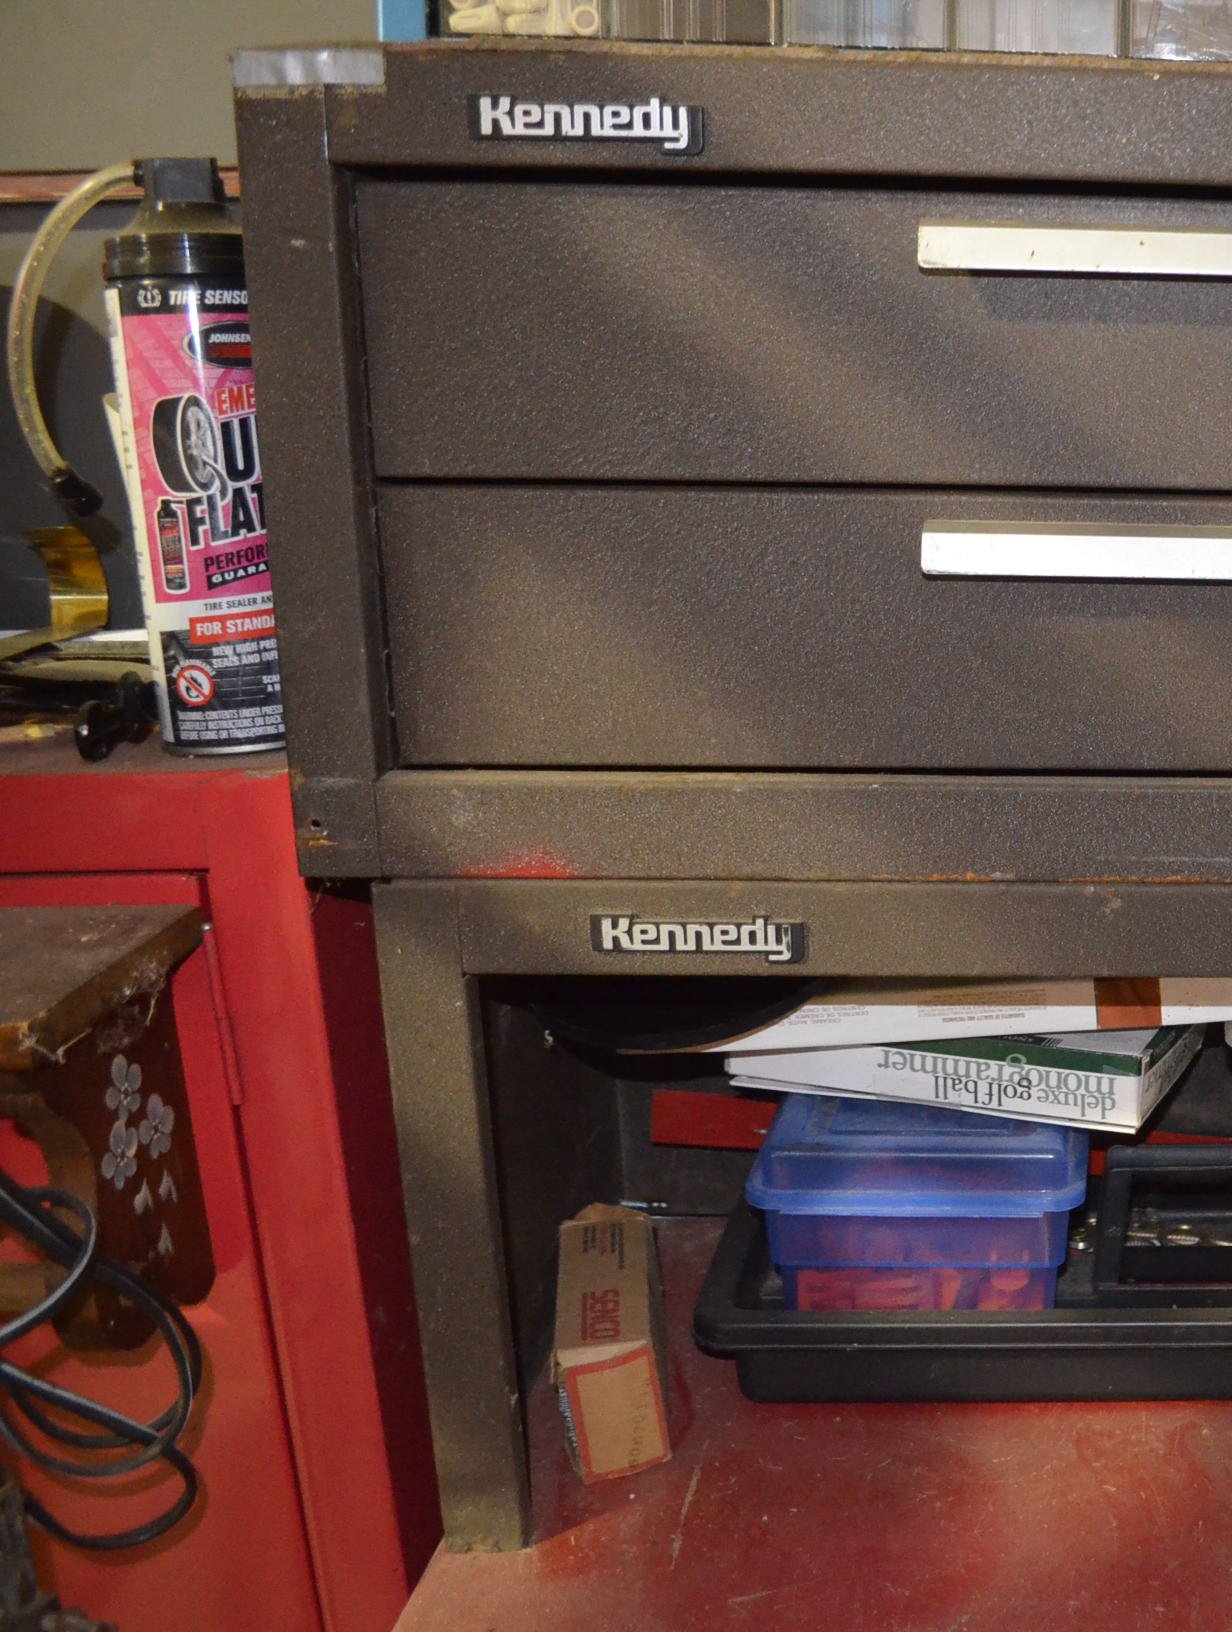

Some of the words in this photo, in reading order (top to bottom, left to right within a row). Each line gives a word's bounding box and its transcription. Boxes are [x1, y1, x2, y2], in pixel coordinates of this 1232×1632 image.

[480, 96, 688, 150] Kennedy
[215, 384, 256, 416] EME
[204, 543, 269, 573] PERFOR
[212, 563, 268, 582] GUARA
[204, 602, 225, 611] TIRE
[226, 597, 258, 609] SEALER
[196, 621, 222, 636] FOR
[212, 645, 234, 656] NEW
[235, 642, 258, 653] HIGH
[212, 657, 240, 668] SEALS
[241, 653, 261, 665] AND
[207, 717, 254, 729] INSTRUCTIONS
[601, 917, 792, 961] Kennedy
[877, 1049, 1117, 1096] monogrammer
[933, 1074, 979, 1104] ball
[982, 1076, 1033, 1107] golf
[1036, 1088, 1117, 1120] deluxe
[589, 1289, 621, 1340] SENCO
